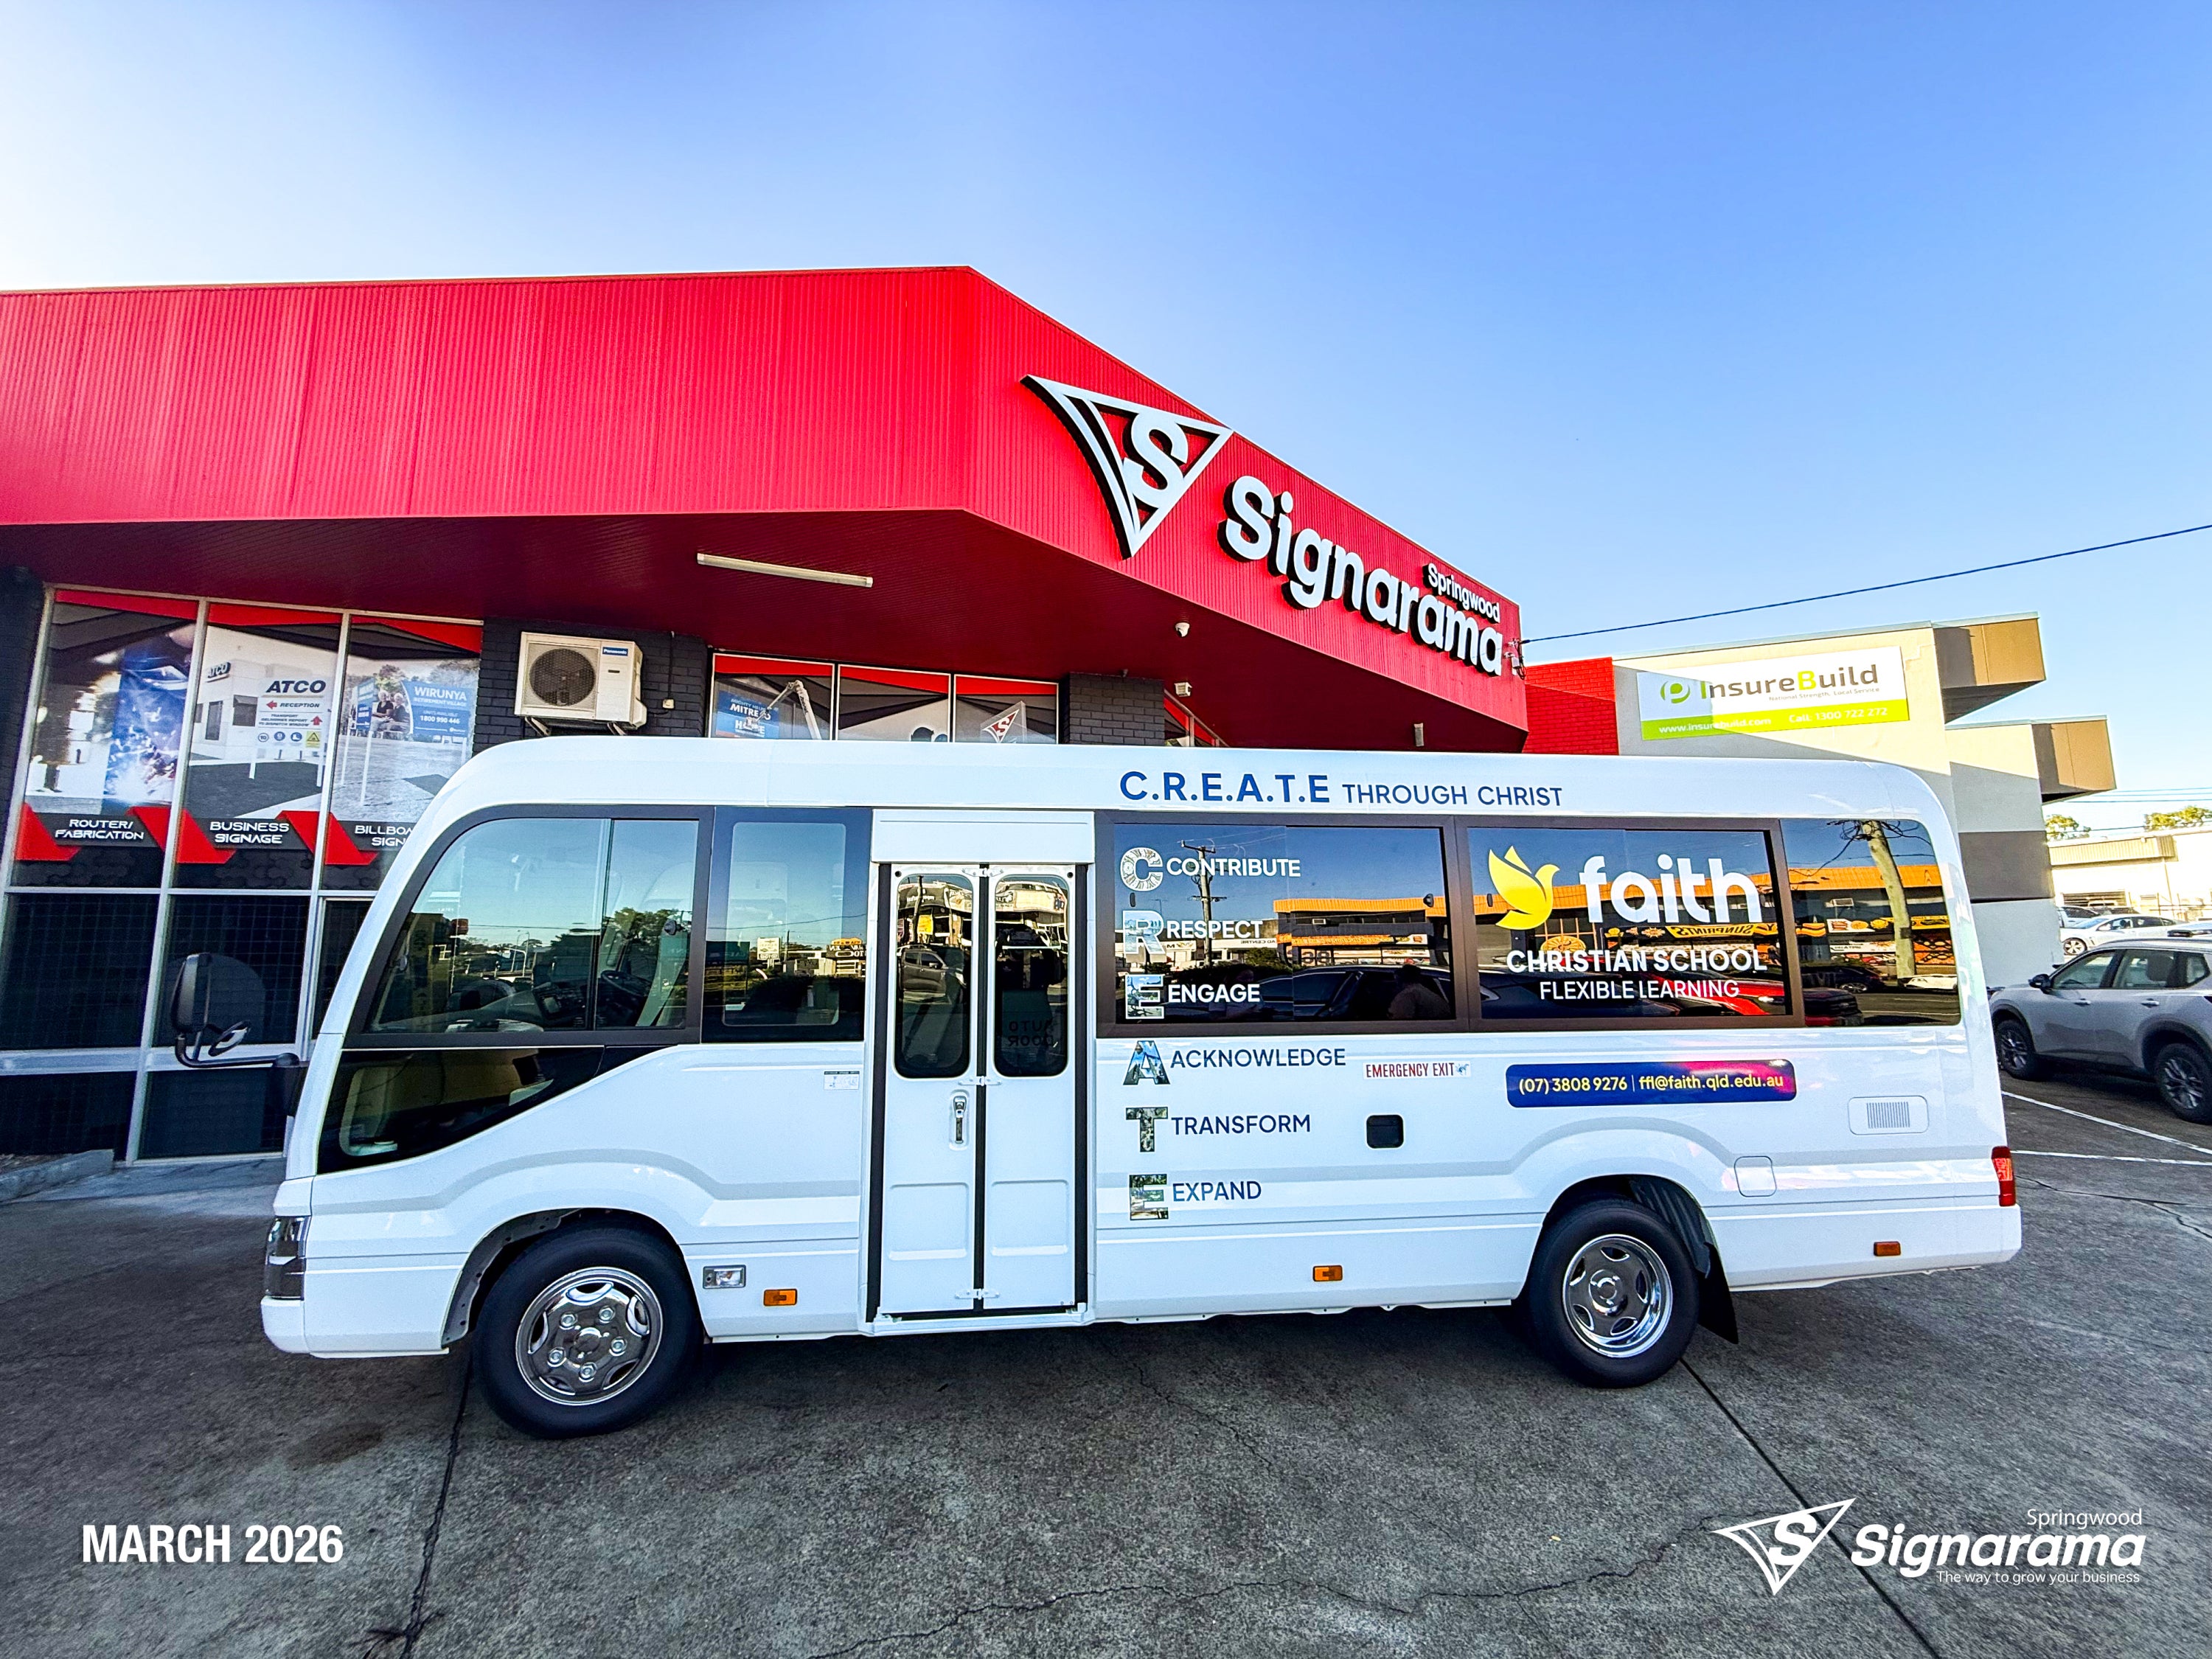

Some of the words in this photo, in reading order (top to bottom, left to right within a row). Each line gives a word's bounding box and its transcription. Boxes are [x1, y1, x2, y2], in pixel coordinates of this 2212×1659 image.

[1221, 476, 1502, 676] Signarama
[1427, 563, 1500, 624] Springwood
[265, 680, 327, 693] ATCO
[414, 686, 467, 701] WIRUNYA
[1700, 664, 1879, 700] InsureBuild
[730, 703, 759, 717] MITRE
[1659, 717, 1772, 734] www.insurebuild.com
[1815, 710, 1843, 721] 1300
[1844, 709, 1865, 718] 722
[1867, 706, 1888, 717] 272
[1120, 771, 1329, 804] C.R.E.A.T.E
[1342, 784, 1467, 806] THROUGH
[1478, 786, 1563, 807] CHRIST
[55, 830, 145, 840] FABRICATION
[69, 819, 133, 829] ROUTER/
[209, 821, 290, 832] BUSINESS
[215, 833, 282, 844] SIGNAGE
[1120, 846, 1164, 891] C
[1166, 858, 1301, 877] CONTRIBUTE
[1579, 854, 1762, 923] faith
[1122, 910, 1166, 955] R
[1166, 920, 1263, 939] RESPECT
[1506, 949, 1649, 973] CHRISTIAN
[1653, 948, 1767, 972] SCHOOL
[1124, 974, 1165, 1020] E
[1168, 984, 1261, 1003] ENGAGE
[1540, 981, 1634, 1000] FLEXIBLE
[1639, 980, 1740, 999] LEARNING
[1123, 1040, 1171, 1085] A
[1170, 1048, 1346, 1068] ACKNOWLEDGE
[1366, 1062, 1428, 1078] EMERGENCY
[1433, 1062, 1455, 1077] EXIT
[1518, 1077, 1549, 1095] (07)
[1552, 1077, 1591, 1092] 3808
[1593, 1076, 1628, 1091] 9276
[1126, 1107, 1169, 1152] T
[1171, 1114, 1311, 1135] TRANSFORM
[1129, 1174, 1169, 1220] E
[1172, 1180, 1262, 1202] EXPAND
